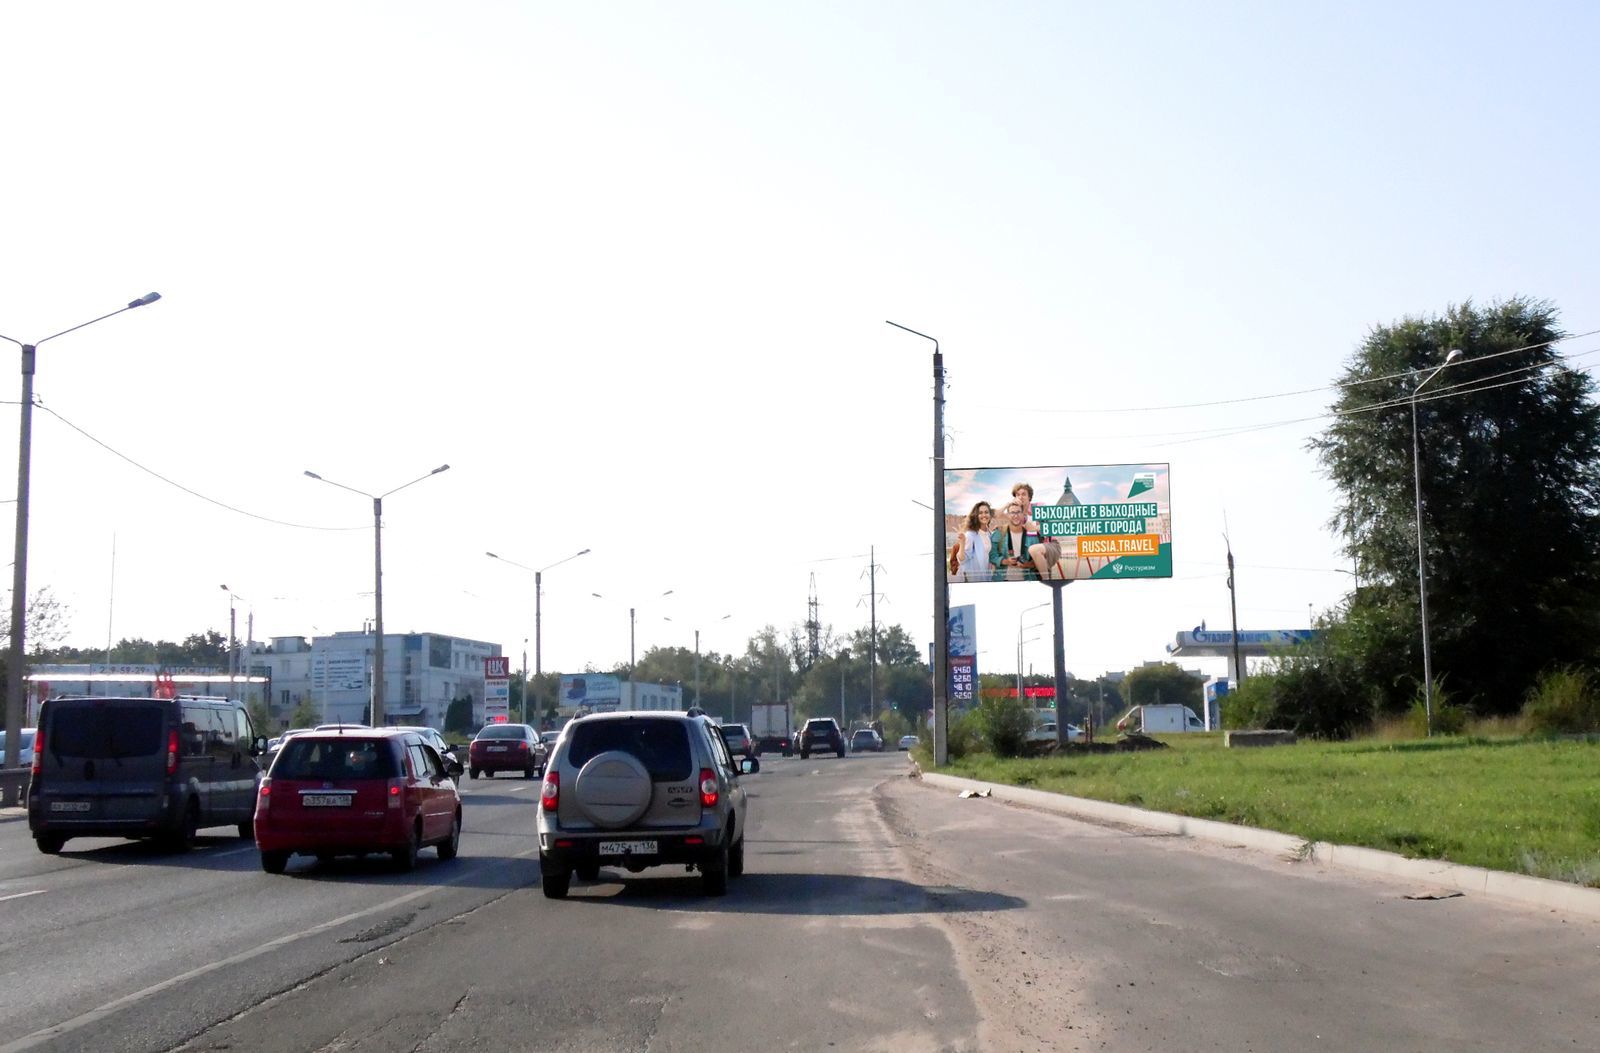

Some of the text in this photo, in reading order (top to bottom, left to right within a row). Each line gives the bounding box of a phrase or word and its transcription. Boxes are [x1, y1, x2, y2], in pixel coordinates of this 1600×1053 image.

[1034, 503, 1156, 519] ВЫХОДИТЕ В ВЫХОДНЫЕ
[1042, 520, 1143, 535] В СОСЕДНИЕ ГОРОДА
[1081, 539, 1155, 553] RUSSIA.TRAVEL
[1124, 564, 1156, 572] Ростуризм
